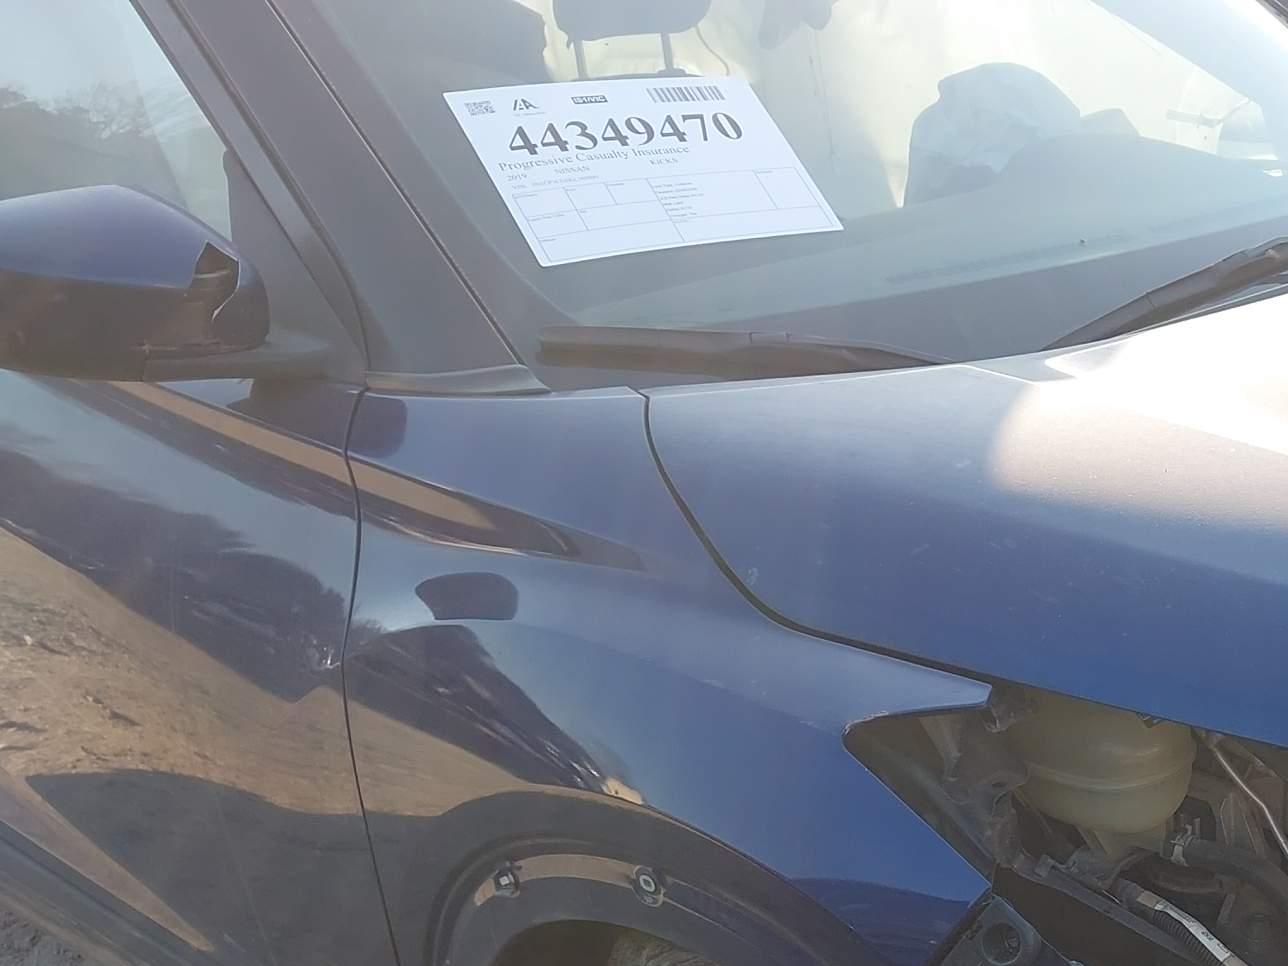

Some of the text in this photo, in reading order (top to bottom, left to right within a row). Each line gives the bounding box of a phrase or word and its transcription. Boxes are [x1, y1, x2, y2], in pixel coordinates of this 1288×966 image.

[508, 112, 743, 156] 44349470
[498, 145, 690, 172] Progressive Casualty Insurance
